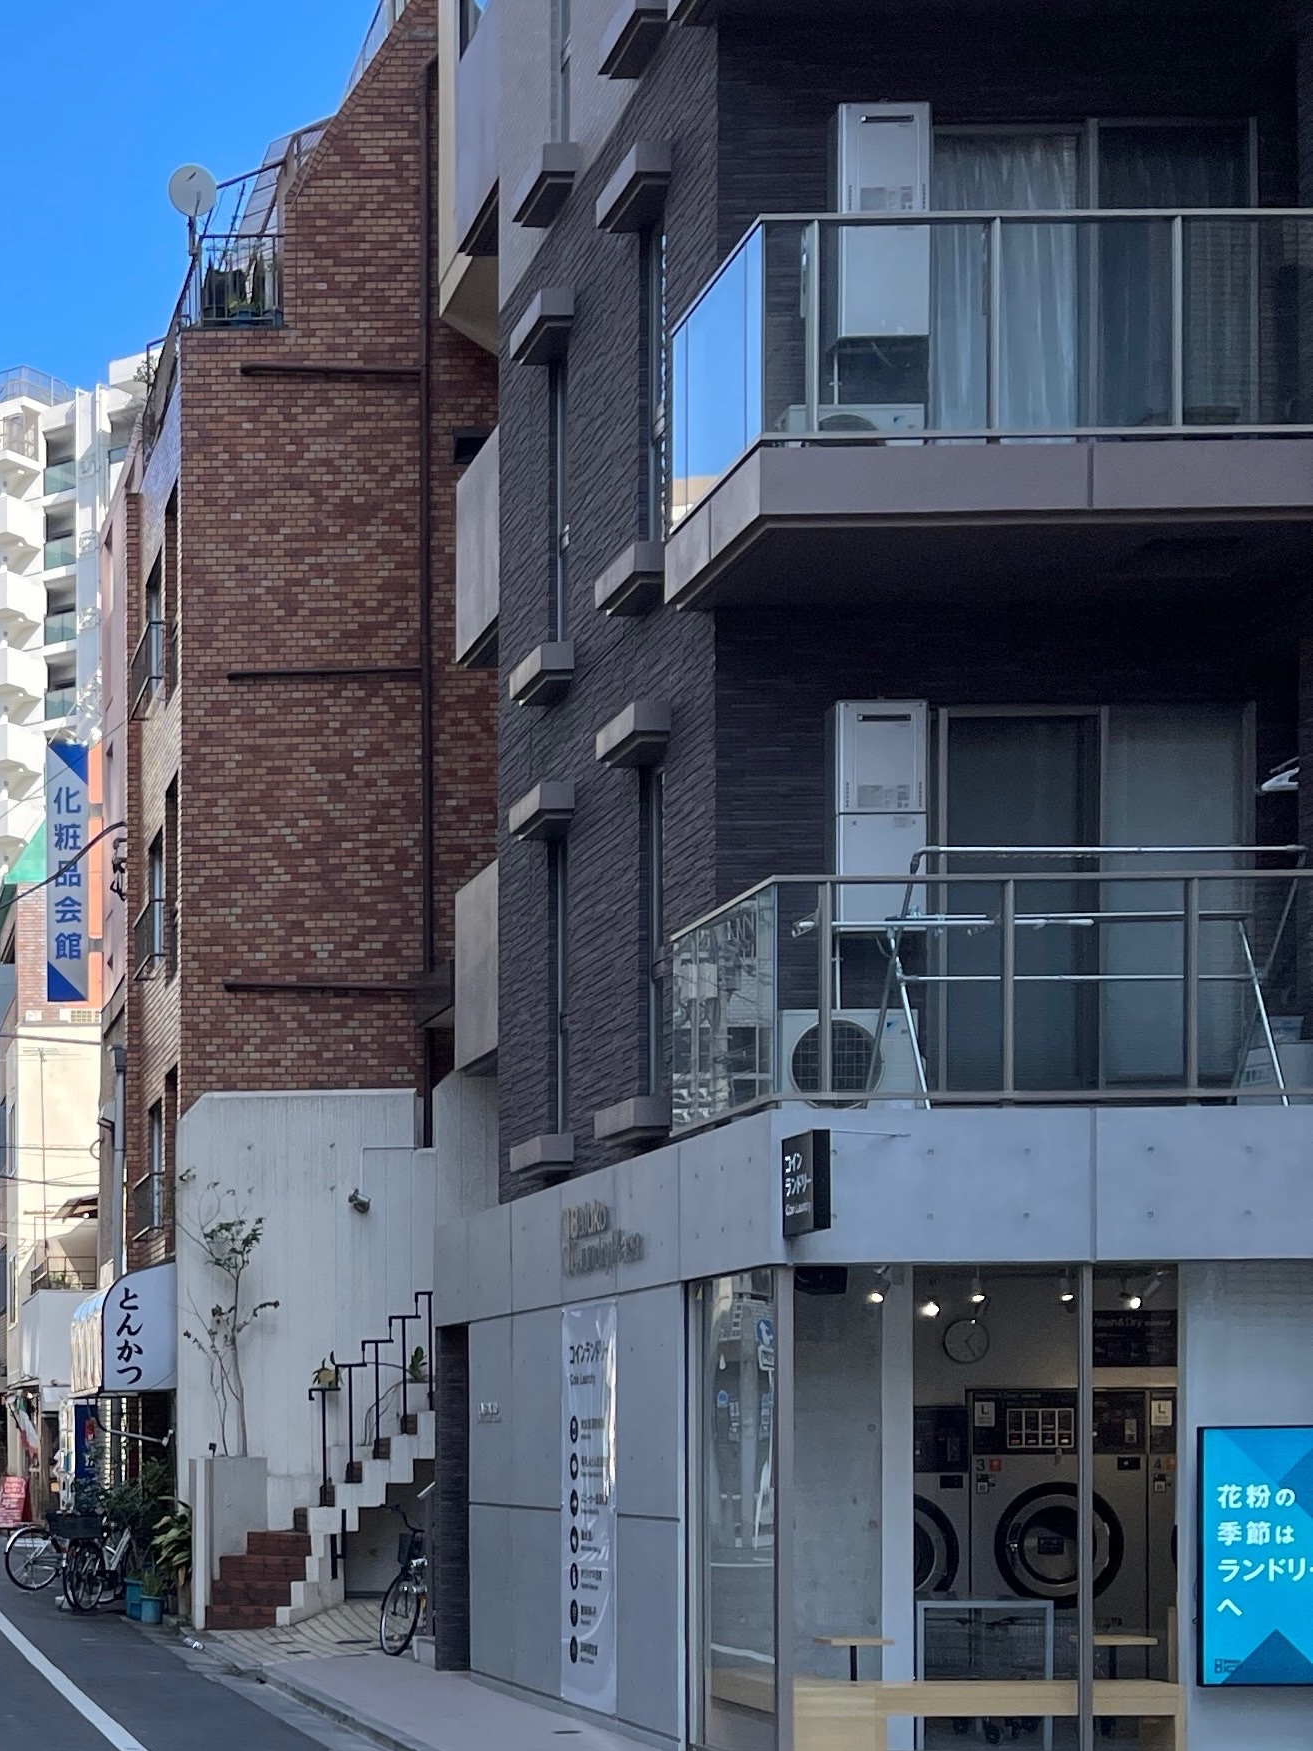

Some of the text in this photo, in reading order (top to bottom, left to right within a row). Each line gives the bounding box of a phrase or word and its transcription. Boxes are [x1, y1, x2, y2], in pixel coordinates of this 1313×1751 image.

[54, 786, 82, 961] 化粧品会館
[785, 1152, 803, 1173] コイン
[785, 1173, 812, 1197] ランドリー
[116, 1287, 143, 1385] とんかつ
[975, 1458, 985, 1471] 3
[1217, 1484, 1295, 1509] 花粉の
[1217, 1521, 1295, 1546] 季節は
[1217, 1558, 1313, 1583] ランドリ
[1217, 1598, 1243, 1617] へ
